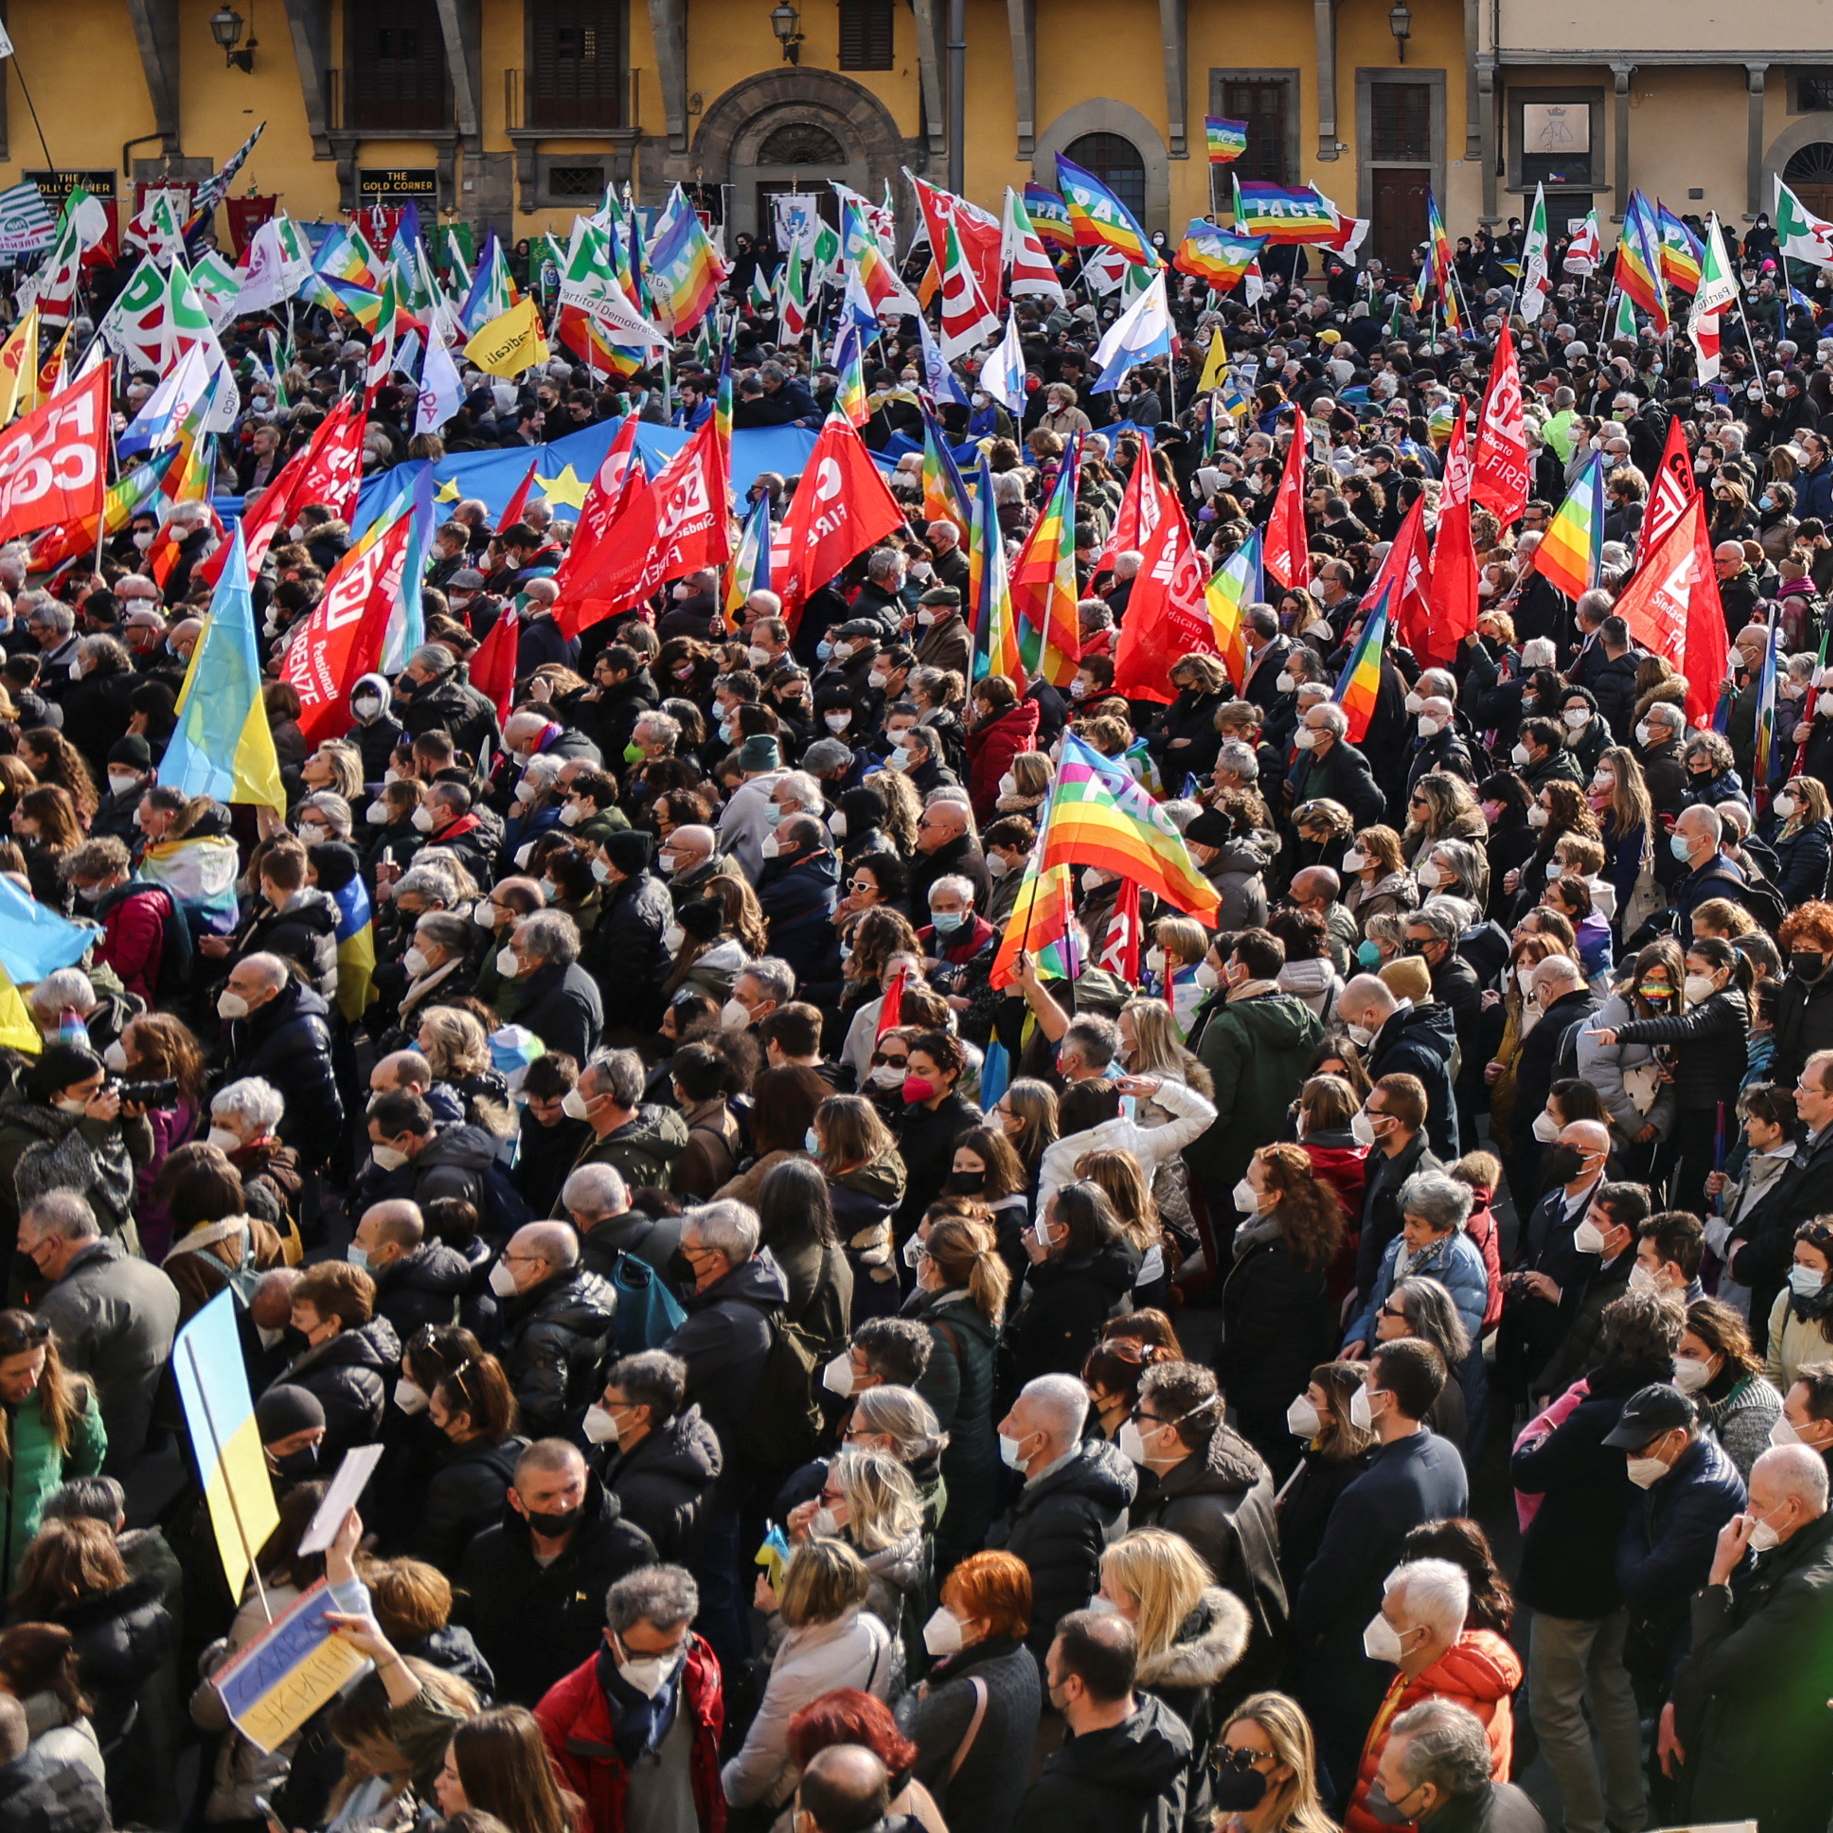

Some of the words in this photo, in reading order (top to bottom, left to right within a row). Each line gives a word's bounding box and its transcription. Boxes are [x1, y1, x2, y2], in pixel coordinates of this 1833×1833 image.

[39, 184, 60, 193] OLD
[64, 184, 110, 193] CNER
[58, 174, 79, 183] THE
[363, 182, 390, 191] GOLD
[393, 181, 433, 190] CORNER
[387, 172, 408, 181] THE
[1037, 202, 1072, 225] PAC
[1073, 187, 1133, 230] PAC
[1257, 200, 1319, 218] PACE
[1663, 226, 1694, 257] PA
[1490, 388, 1525, 438] SP
[1486, 454, 1530, 494] FIREN
[1669, 453, 1691, 499] CG
[1167, 610, 1202, 634] dacato
[1651, 590, 1687, 629] Sindaca
[313, 640, 340, 701] Pensionati
[1083, 769, 1179, 837] PAC
